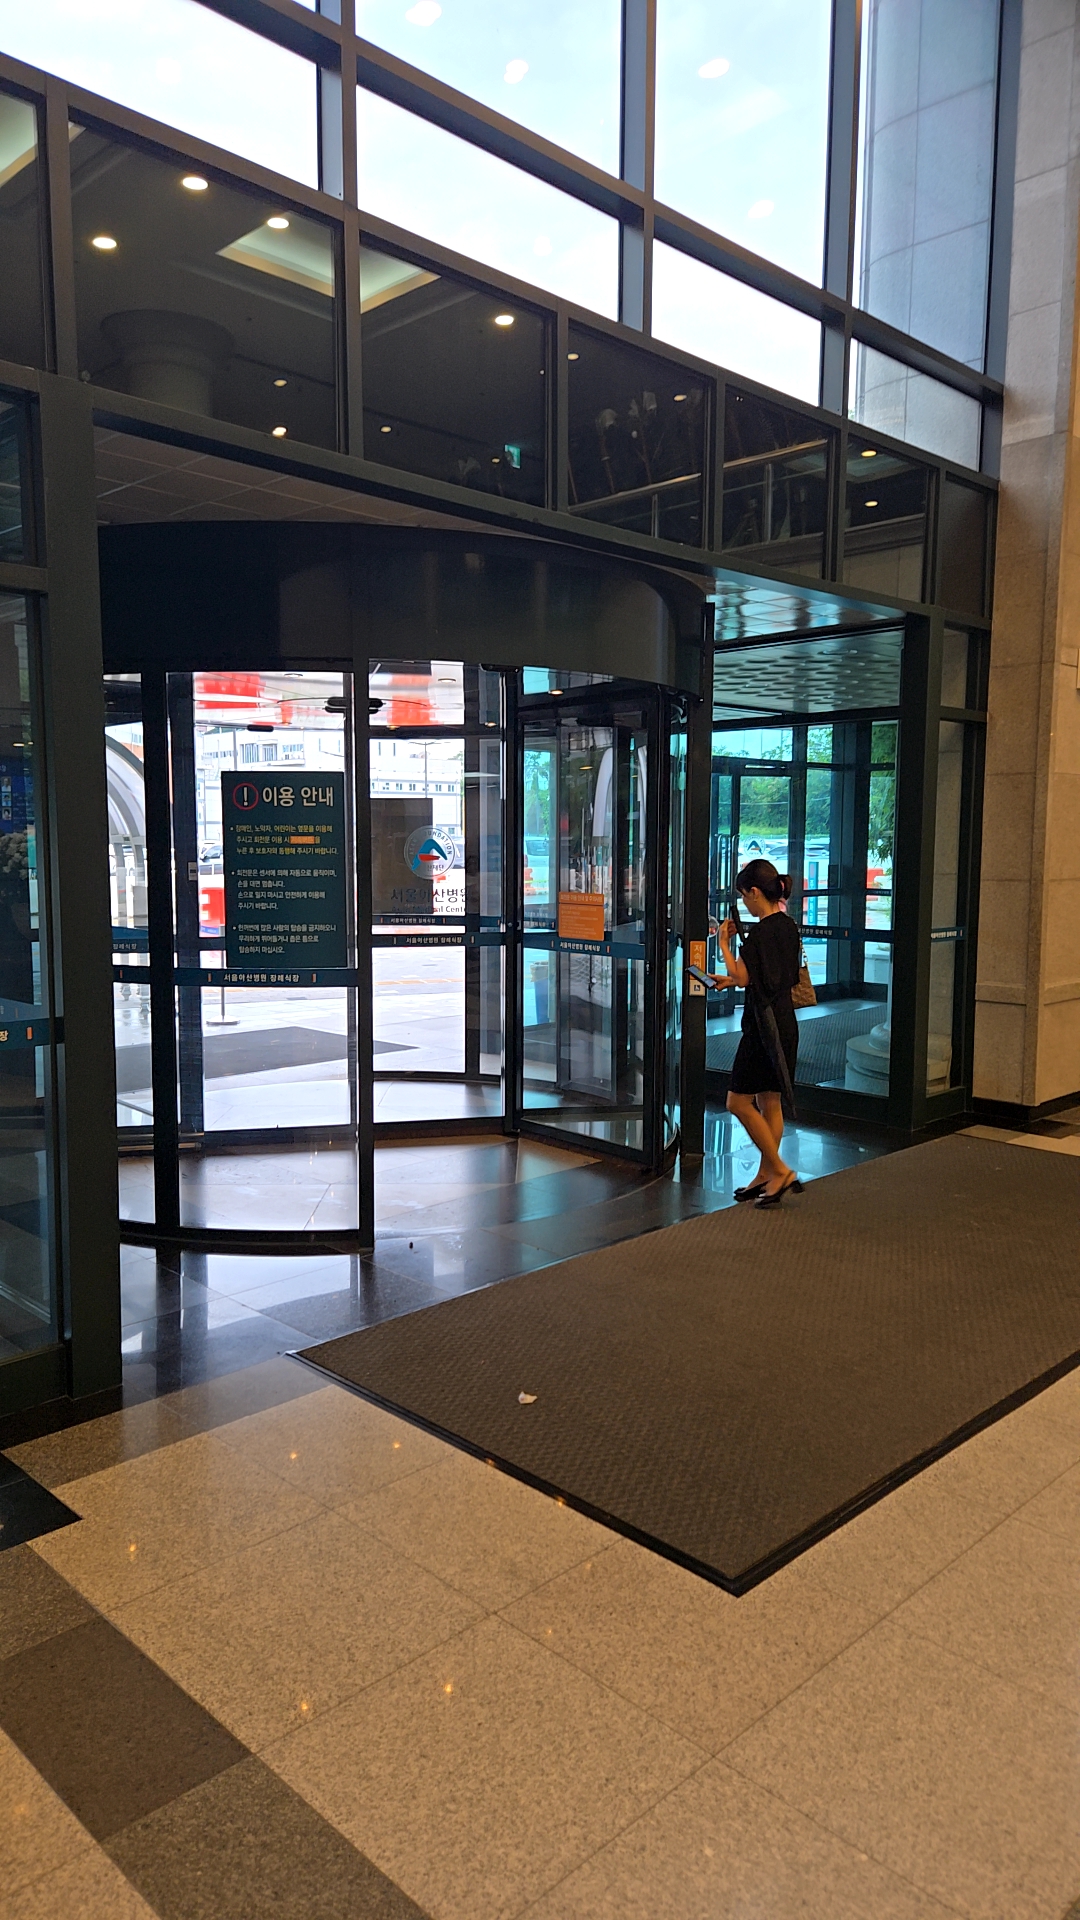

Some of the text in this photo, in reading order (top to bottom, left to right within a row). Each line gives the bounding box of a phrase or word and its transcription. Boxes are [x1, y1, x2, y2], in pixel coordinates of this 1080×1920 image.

[262, 786, 333, 806] 이용 안내
[694, 945, 702, 970] 저속버
[224, 974, 300, 982] 서울아산병원 장례식장
